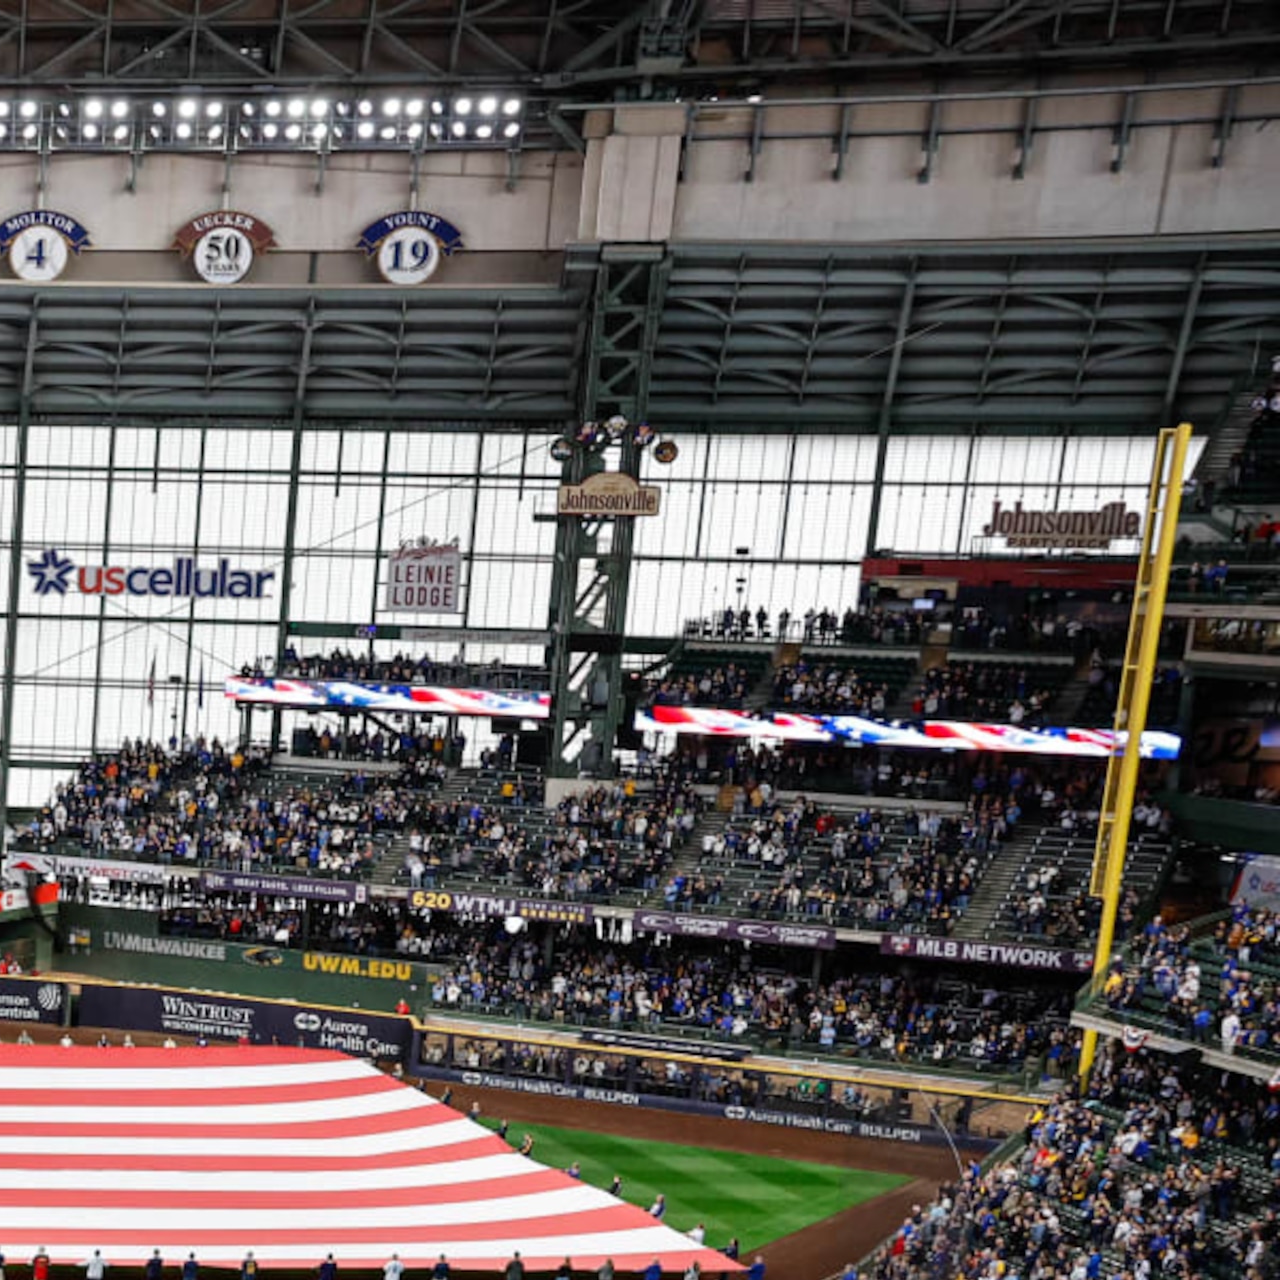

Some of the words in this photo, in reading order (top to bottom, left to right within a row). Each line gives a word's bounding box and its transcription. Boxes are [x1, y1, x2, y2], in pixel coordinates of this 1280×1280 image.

[5, 211, 77, 234] MOLITOR
[192, 212, 256, 232] UECKER
[383, 211, 442, 232] YOUNT
[24, 237, 48, 269] 4
[204, 235, 240, 260] 50
[388, 238, 431, 272] 19
[560, 488, 656, 511] Johnsonville
[982, 500, 1141, 537] Johnsonville
[1006, 537, 1059, 548] PARTY
[1065, 537, 1110, 549] DECK
[394, 564, 455, 585] LEINIE
[392, 586, 454, 607] LODGE
[412, 890, 452, 909] 620
[454, 895, 516, 916] WTMJ
[520, 908, 586, 923] BREWERS
[915, 938, 959, 958] MLB
[961, 944, 1062, 968] NETWORK
[302, 952, 412, 981] UWM.EDU
[161, 996, 255, 1023] WINTRUST
[321, 1017, 369, 1036] Aurora
[366, 1037, 401, 1056] Care
[482, 1075, 516, 1089] Aurora
[518, 1078, 551, 1096] Health
[552, 1082, 578, 1098] Care
[583, 1087, 639, 1105] BULLPEN
[748, 1109, 785, 1126] Aurora
[786, 1112, 824, 1131] Health
[824, 1118, 854, 1134] Care
[859, 1123, 921, 1142] BULLPEN
